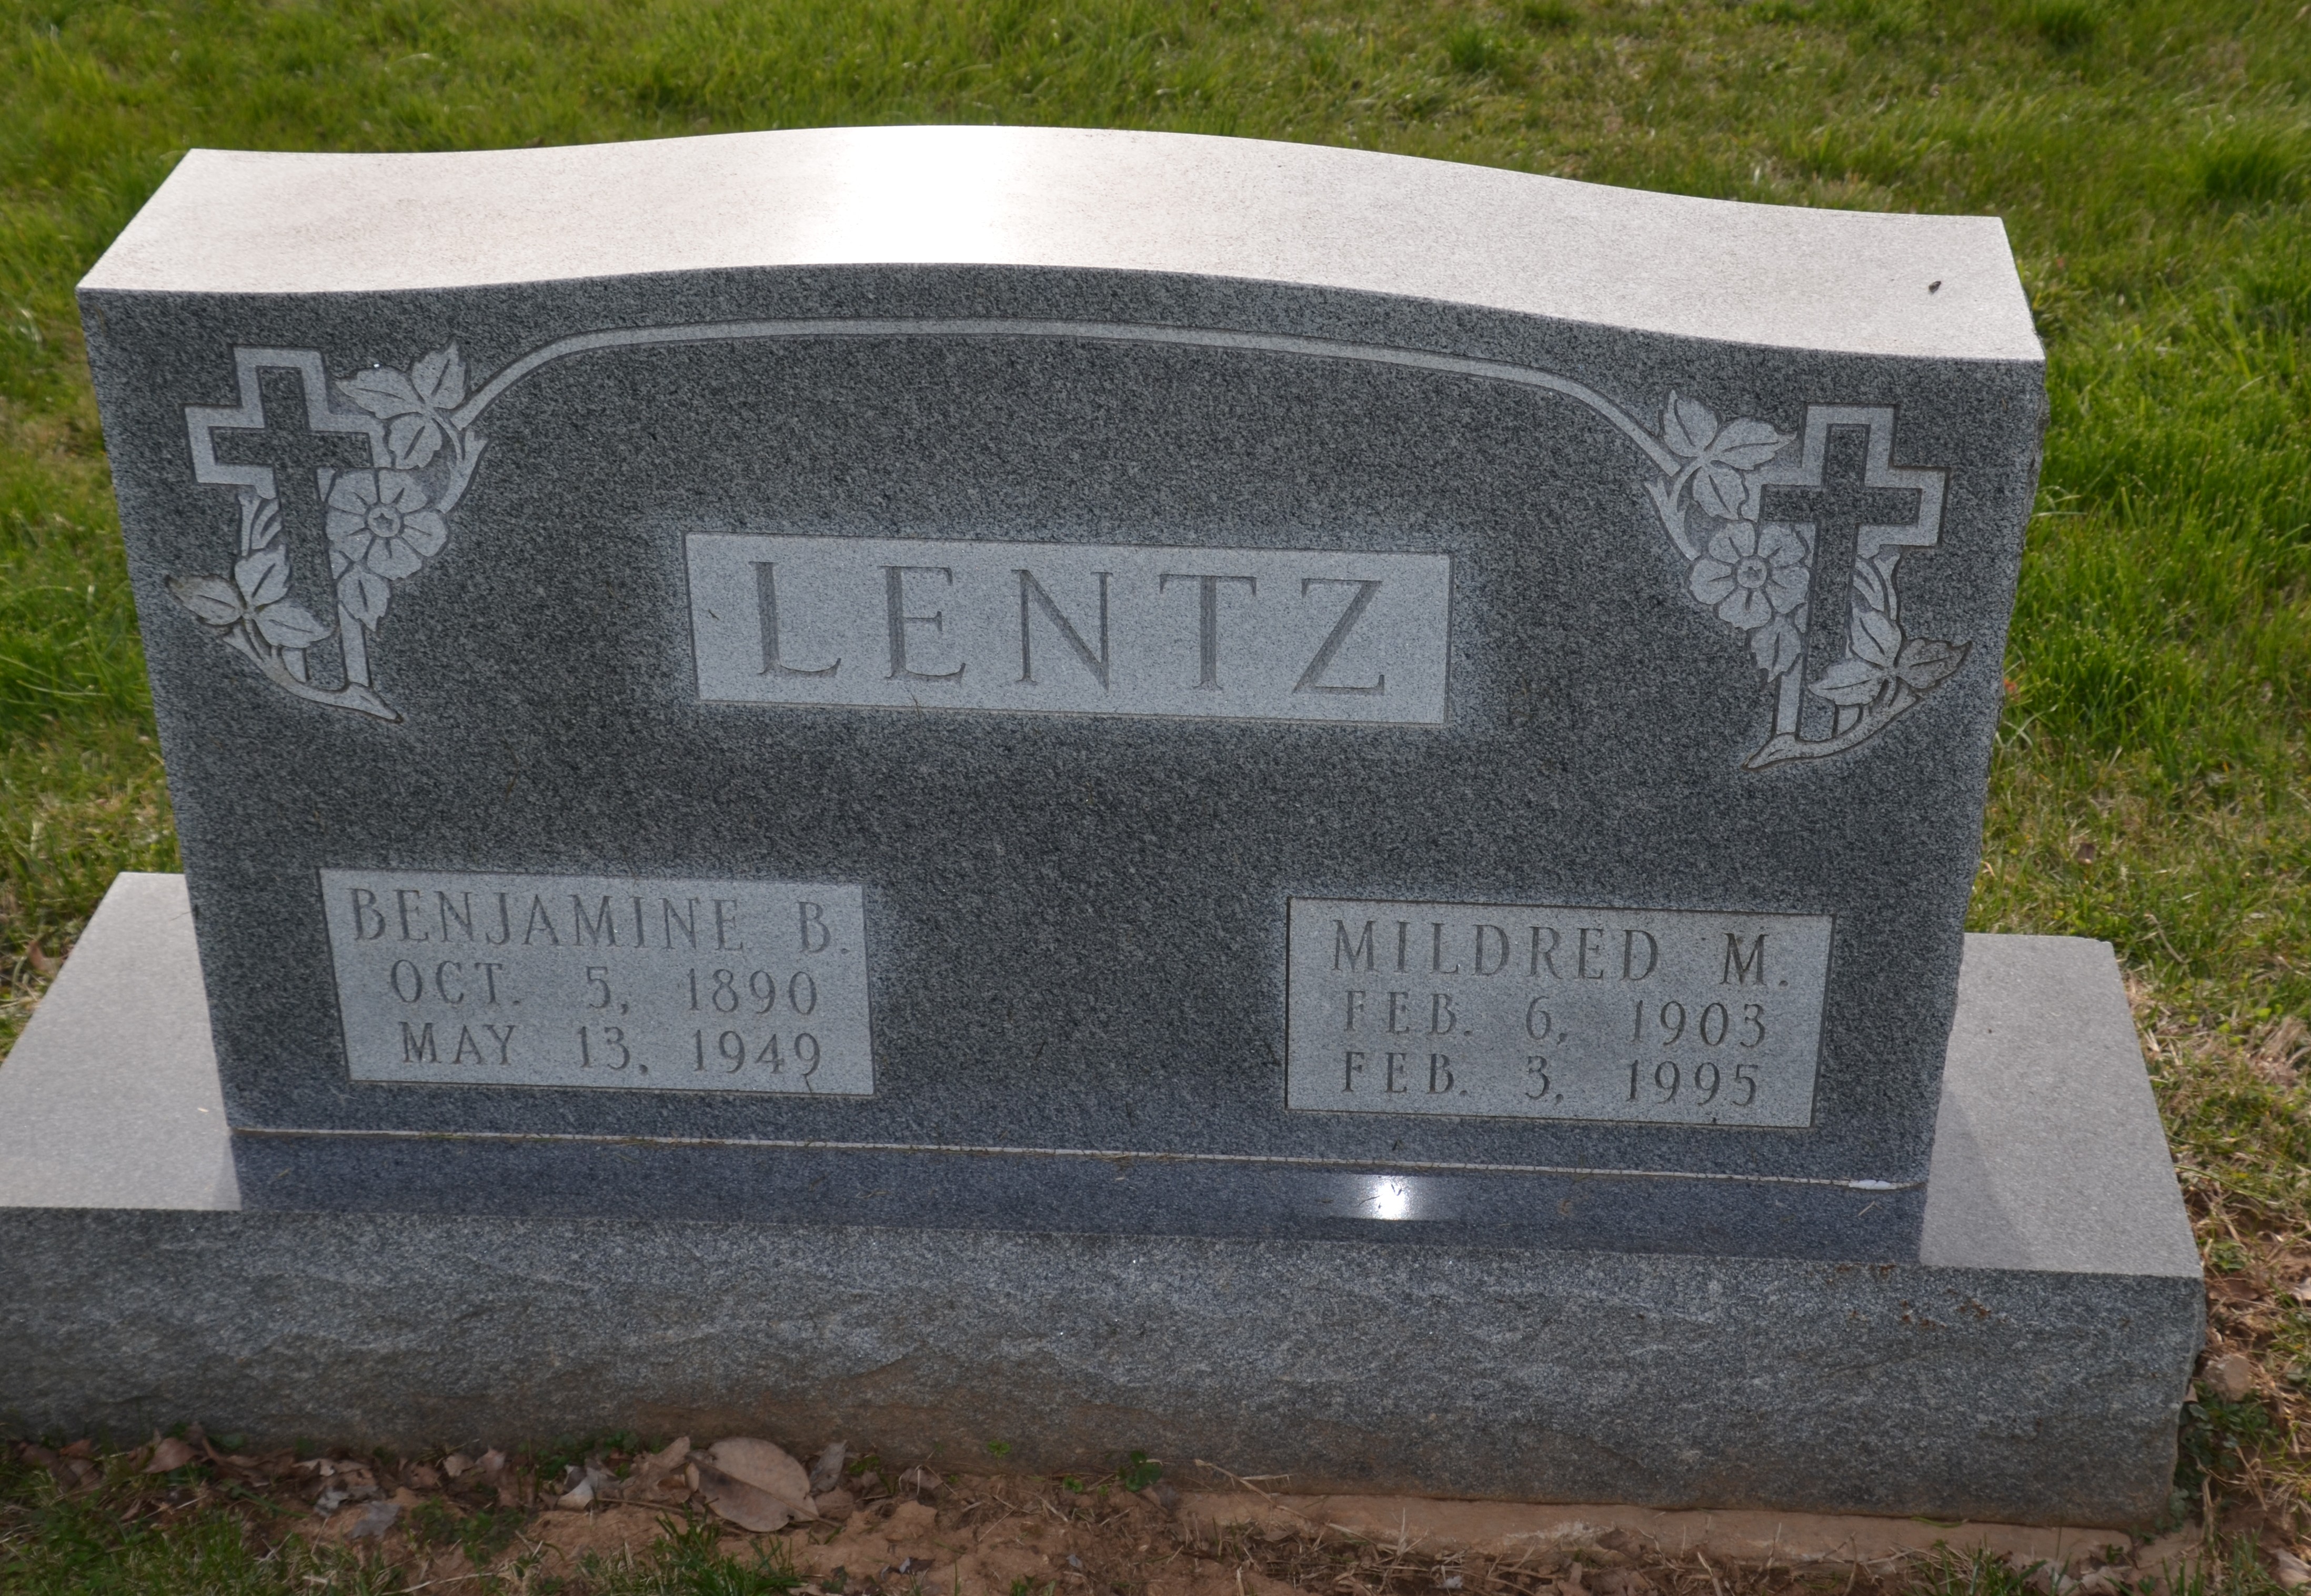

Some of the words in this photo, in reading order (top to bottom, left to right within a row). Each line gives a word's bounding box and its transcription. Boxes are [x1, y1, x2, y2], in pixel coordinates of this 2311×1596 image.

[747, 561, 1385, 697] LENTZ
[350, 887, 744, 950] BENJAMINE
[797, 901, 850, 955] B.
[1331, 919, 1659, 982] MILDRED
[1719, 932, 1788, 987] M.
[389, 959, 521, 1006] OCT.
[586, 966, 630, 1015] 5,
[687, 967, 818, 1015] 1890
[1343, 990, 1472, 1037] FEB.
[1525, 996, 1567, 1045] 6,
[1632, 1000, 1766, 1048] 1903
[399, 1021, 516, 1065] MAY
[578, 1026, 649, 1076] 13,
[691, 1030, 821, 1076] 1949
[1341, 1052, 1469, 1096] FEB.
[1525, 1056, 1564, 1105] 3,
[1626, 1059, 1759, 1107] 1995
